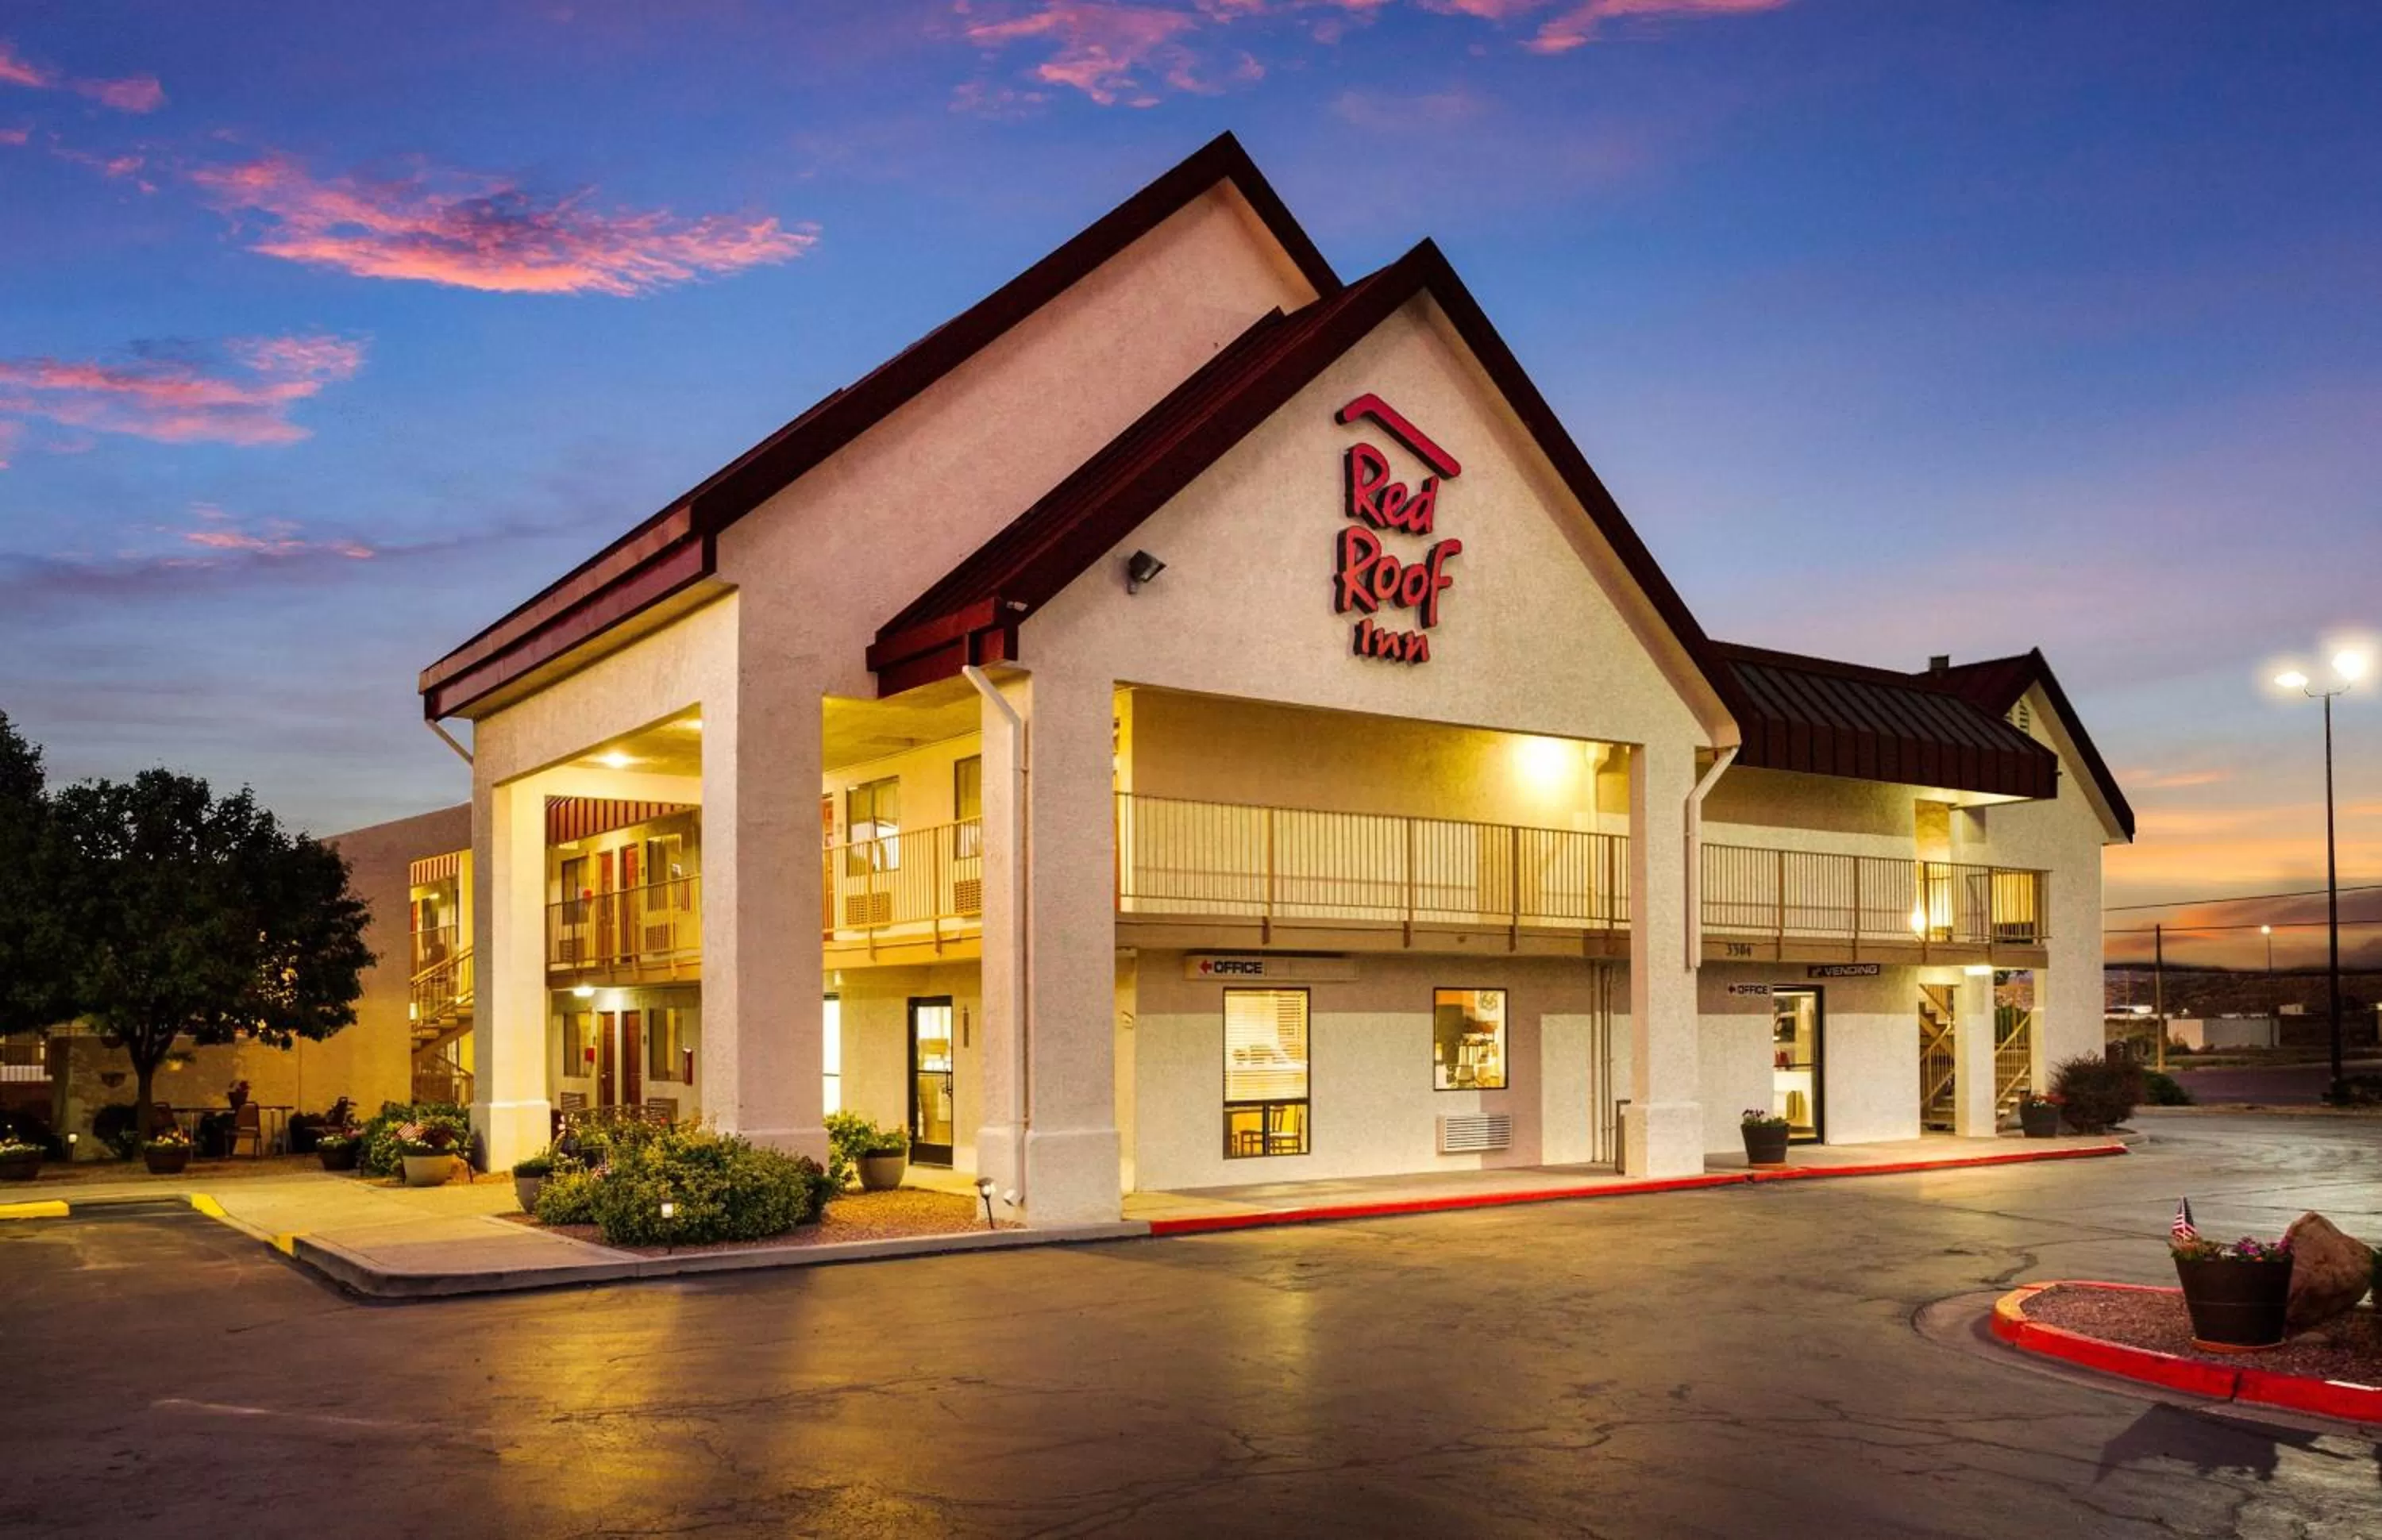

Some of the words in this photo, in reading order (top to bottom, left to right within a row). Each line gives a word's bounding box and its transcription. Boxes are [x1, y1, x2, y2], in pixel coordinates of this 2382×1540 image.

[1343, 443, 1439, 533] Red
[1334, 525, 1462, 628] Roof
[1214, 961, 1262, 974] OFFICE
[1824, 964, 1878, 976] VENDING
[1737, 984, 1769, 995] OFFICE
